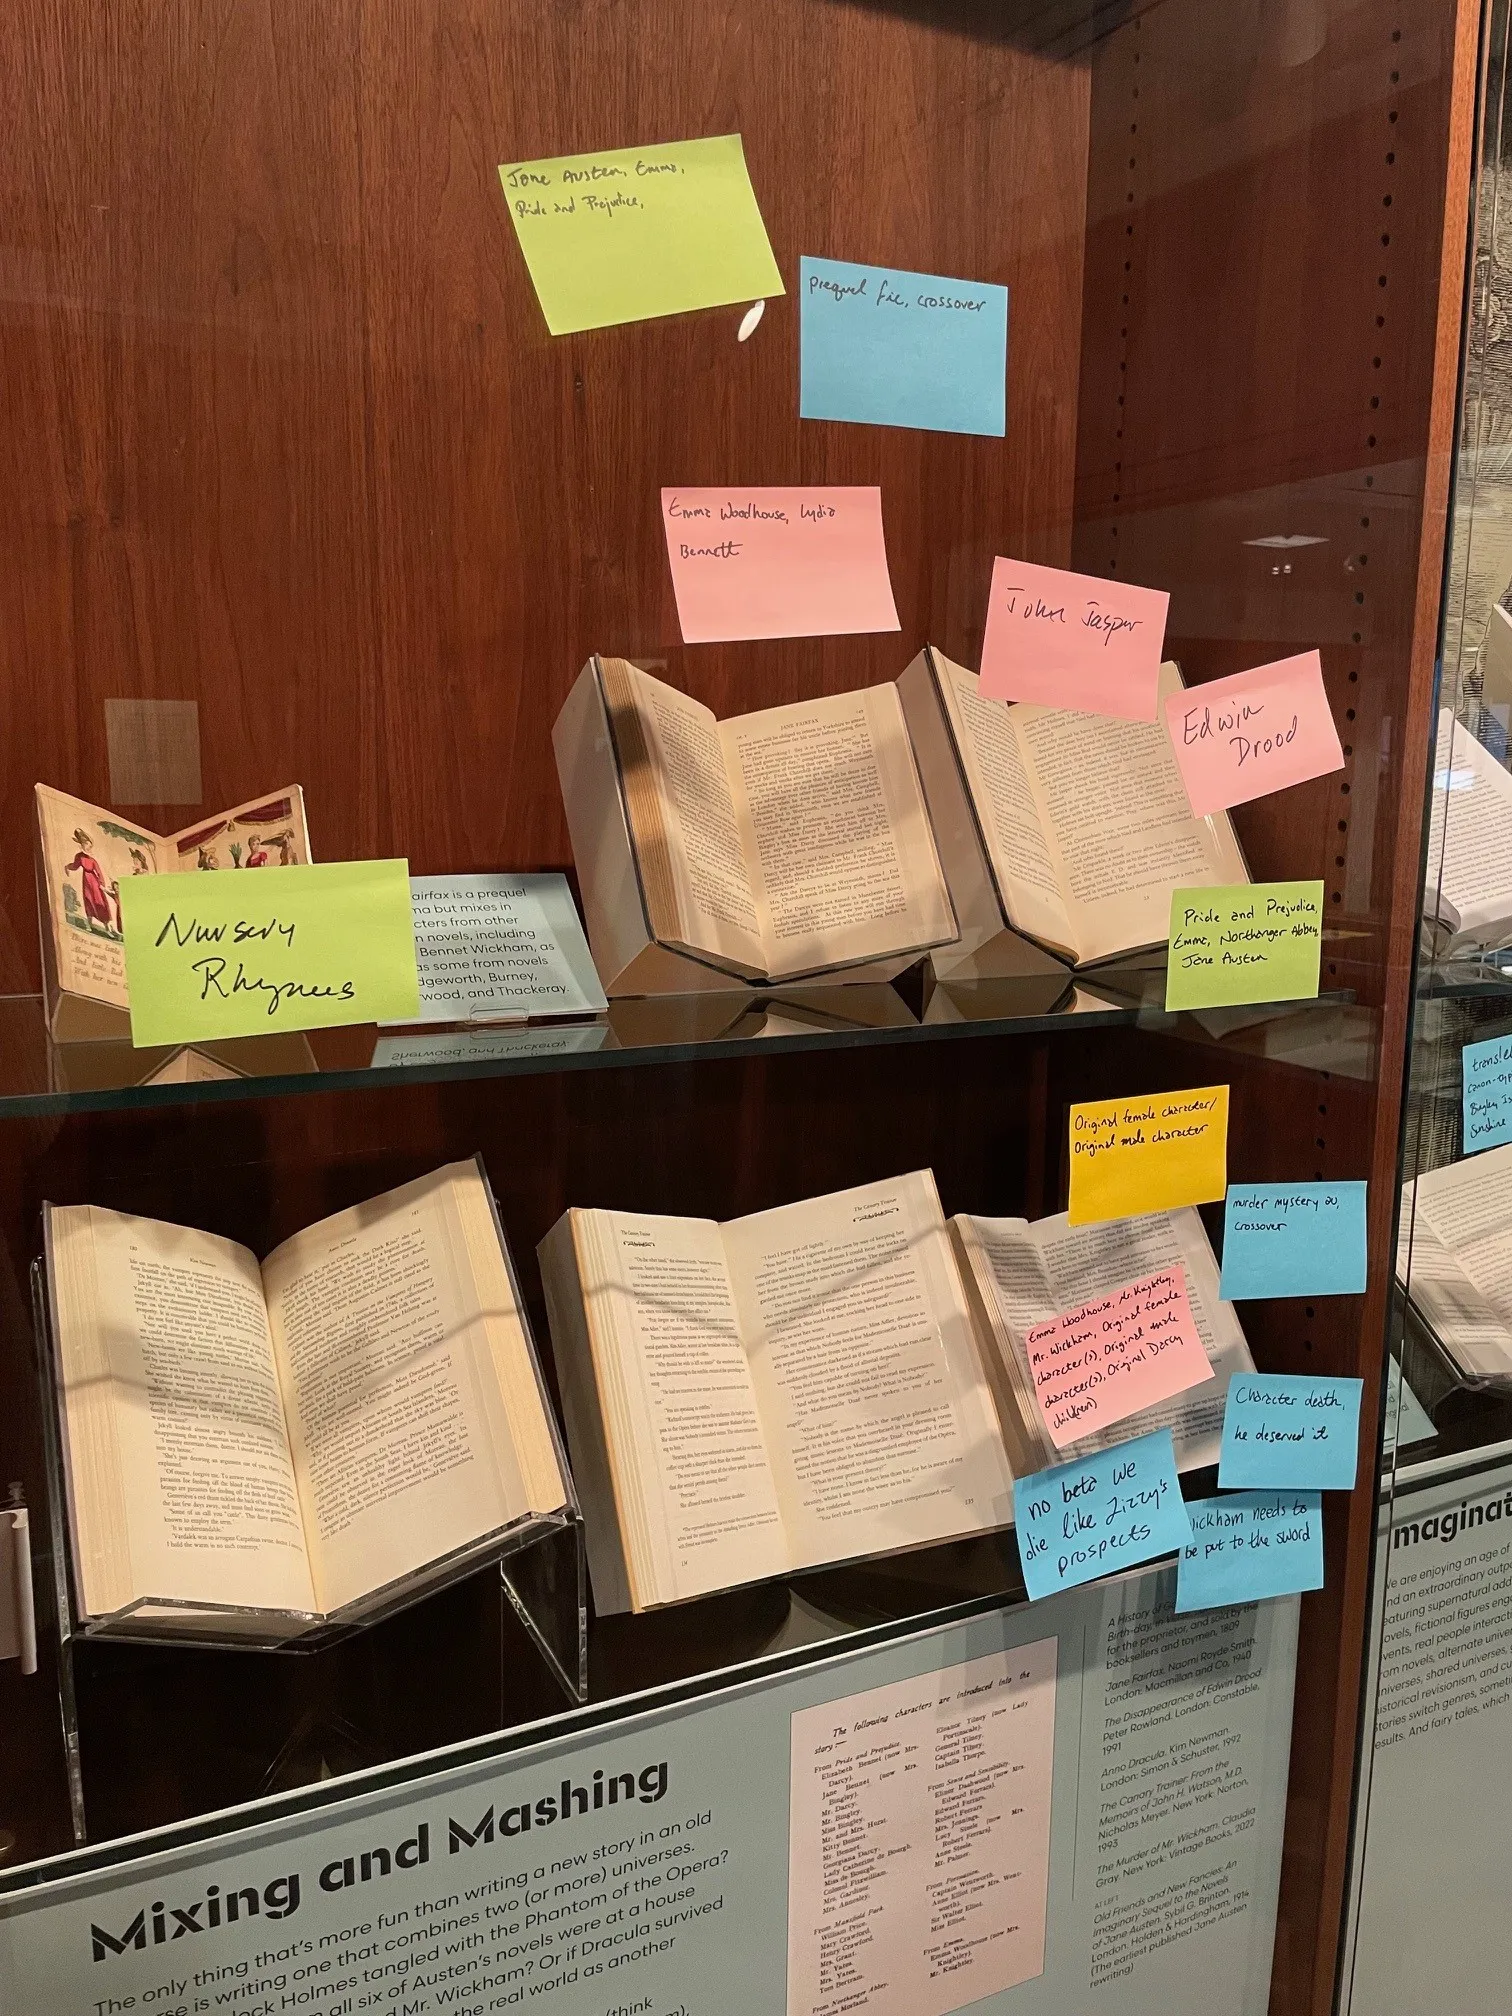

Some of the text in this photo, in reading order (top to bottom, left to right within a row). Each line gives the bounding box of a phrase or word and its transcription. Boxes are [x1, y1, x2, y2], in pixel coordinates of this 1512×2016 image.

[506, 160, 685, 188] Jane Austen, Emma,
[514, 191, 644, 219] Pride and Prejudice,
[809, 275, 987, 312] prequel fic, crossover
[668, 496, 836, 525] Emma Woodhouse, Lydia
[680, 540, 744, 560] Bennett
[1081, 601, 1144, 647] Jasper
[1183, 700, 1266, 748] Edwin
[1229, 712, 1298, 767] Drood
[411, 890, 449, 901] airfax
[465, 891, 474, 899] a
[477, 888, 527, 900] prequel
[434, 904, 457, 914] but
[460, 904, 498, 912] mixes
[413, 915, 518, 928] cters from other
[1184, 898, 1316, 927] Pride and Prejudice,
[419, 943, 555, 957] Bennet Wickham, as
[427, 928, 536, 942] novels, including
[1173, 932, 1211, 950] Emma,
[1219, 928, 1288, 947] Northanger
[433, 961, 470, 971] some
[472, 958, 505, 968] from
[507, 955, 549, 967] novels
[1181, 951, 1268, 968] Jane Austen
[417, 972, 538, 988] dgeworth, Burney,
[421, 984, 570, 1001] wood, and Thackeray.
[1074, 1096, 1218, 1135] Original female character/
[1074, 1123, 1209, 1158] Original male character
[1232, 1194, 1269, 1210] murder
[1274, 1195, 1319, 1214] mystery
[1028, 1326, 1058, 1346] Emma
[1061, 1301, 1117, 1330] Woodhouse,
[1133, 1275, 1177, 1300] Knightley,
[1032, 1289, 1182, 1366] Mr. Wickham, Original female
[1103, 1326, 1145, 1356] Original
[1149, 1311, 1180, 1330] male
[1106, 1348, 1147, 1376] Original
[1145, 1335, 1184, 1356] Darcy
[1235, 1386, 1345, 1411] Character death,
[1234, 1422, 1329, 1443] he deserved it
[1028, 1498, 1051, 1521] no
[1061, 1476, 1098, 1504] beta
[1250, 1497, 1287, 1521] needs
[1290, 1499, 1310, 1516] to
[1026, 1476, 1168, 1561] die like Lizzy's
[1058, 1521, 1154, 1579] prospects
[1185, 1521, 1311, 1560] be put to the sword
[1400, 1542, 1511, 1586] are enjoying an age of
[1418, 1570, 1486, 1598] extraordinary
[1427, 1582, 1491, 1612] supernatural
[1105, 1680, 1130, 1692] Jane
[1168, 1656, 1199, 1673] Naomi
[1104, 1717, 1122, 1728] The
[1123, 1693, 1195, 1722] Disappearance
[1196, 1685, 1206, 1698] of
[1207, 1679, 1233, 1694] Edwin
[1408, 1701, 1440, 1719] switch
[833, 1726, 847, 1738] The
[853, 1715, 889, 1732] following
[894, 1701, 933, 1718] characters
[1097, 1863, 1114, 1875] The
[1116, 1850, 1149, 1868] Murder
[1151, 1843, 1161, 1854] of
[1221, 1807, 1256, 1826] Claudia
[90, 1757, 670, 1963] Mixing and Mashing
[93, 1809, 711, 2016] The only thing that's more fun than writing a new story in an old
